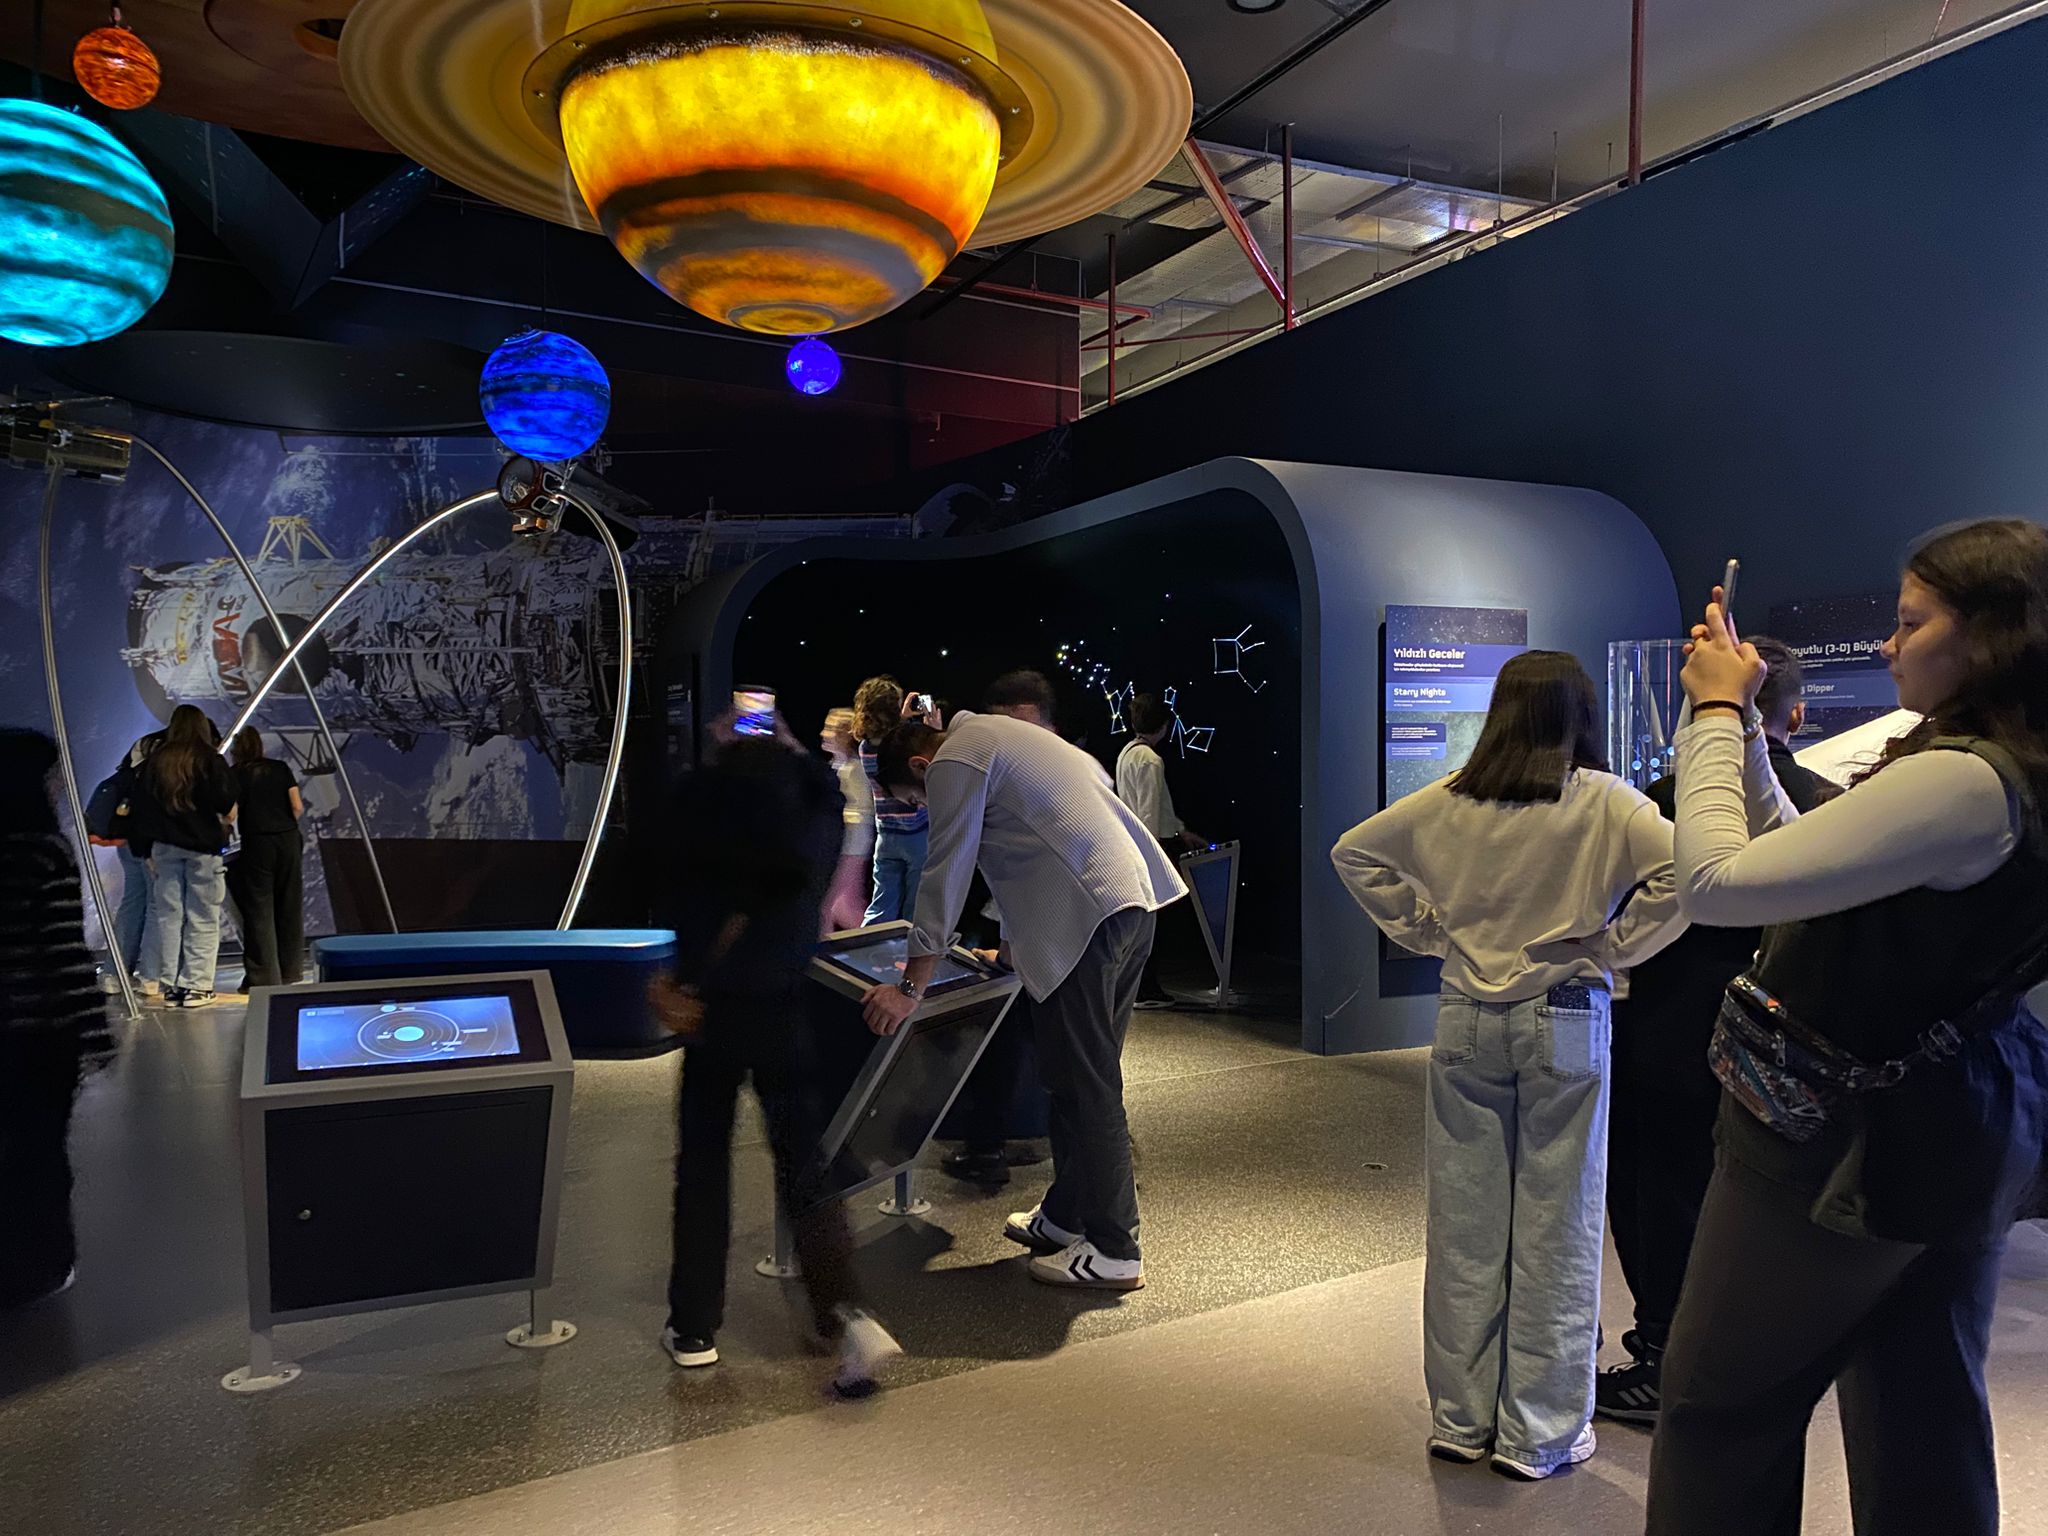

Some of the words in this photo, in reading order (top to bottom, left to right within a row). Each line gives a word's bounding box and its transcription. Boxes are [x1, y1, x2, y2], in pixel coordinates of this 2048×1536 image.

[1429, 649, 1465, 659] Geceler
[1789, 645, 1822, 657] oyutlu
[1825, 643, 1850, 655] (3-D)
[1394, 688, 1418, 697] Starry
[1420, 688, 1446, 697] Nights
[1807, 684, 1834, 693] Dipper
